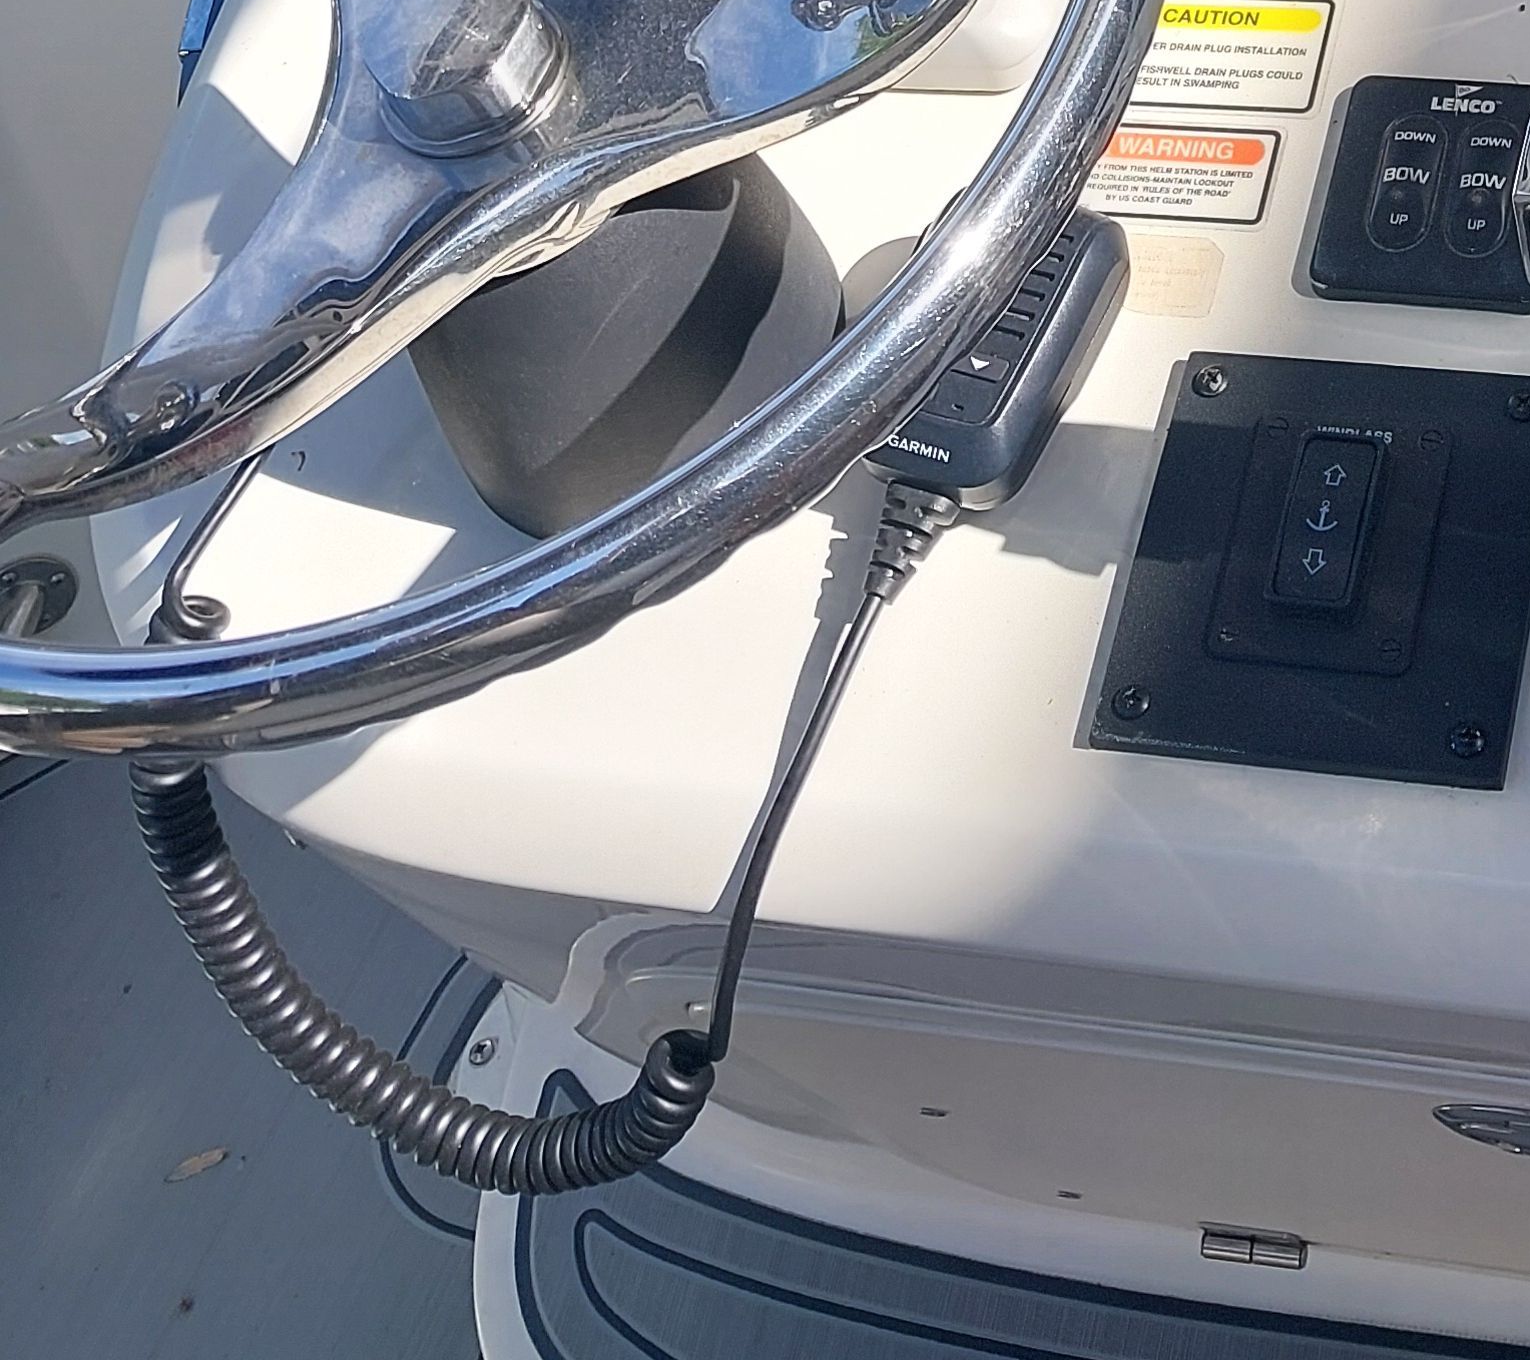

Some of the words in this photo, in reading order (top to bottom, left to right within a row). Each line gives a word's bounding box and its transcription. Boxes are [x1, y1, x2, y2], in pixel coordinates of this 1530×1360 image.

[1163, 8, 1260, 26] CAUTION
[1169, 42, 1202, 52] DRAIN
[1204, 44, 1232, 53] PLUG
[1234, 45, 1308, 57] INSTALLATION
[1194, 67, 1227, 77] DRAIN
[1229, 68, 1264, 79] PLUGS
[1266, 70, 1304, 80] COULD
[1136, 77, 1168, 86] ESULT
[1170, 78, 1180, 87] IN
[1430, 95, 1497, 115] LENCO
[1394, 131, 1436, 144] DOWN
[1470, 136, 1512, 149] DOWN
[1119, 137, 1235, 160] WARNING
[1174, 167, 1209, 176] STATION
[1383, 166, 1431, 184] BOW
[1193, 179, 1235, 188] LOOKOUT
[1459, 173, 1507, 190] BOW
[1172, 187, 1183, 195] OF
[1186, 188, 1202, 196] THE
[1132, 196, 1161, 204] COAST
[1162, 197, 1193, 205] GUARD
[1390, 213, 1409, 227] UP
[1467, 218, 1486, 231] UP
[887, 433, 950, 463] GARMIN
